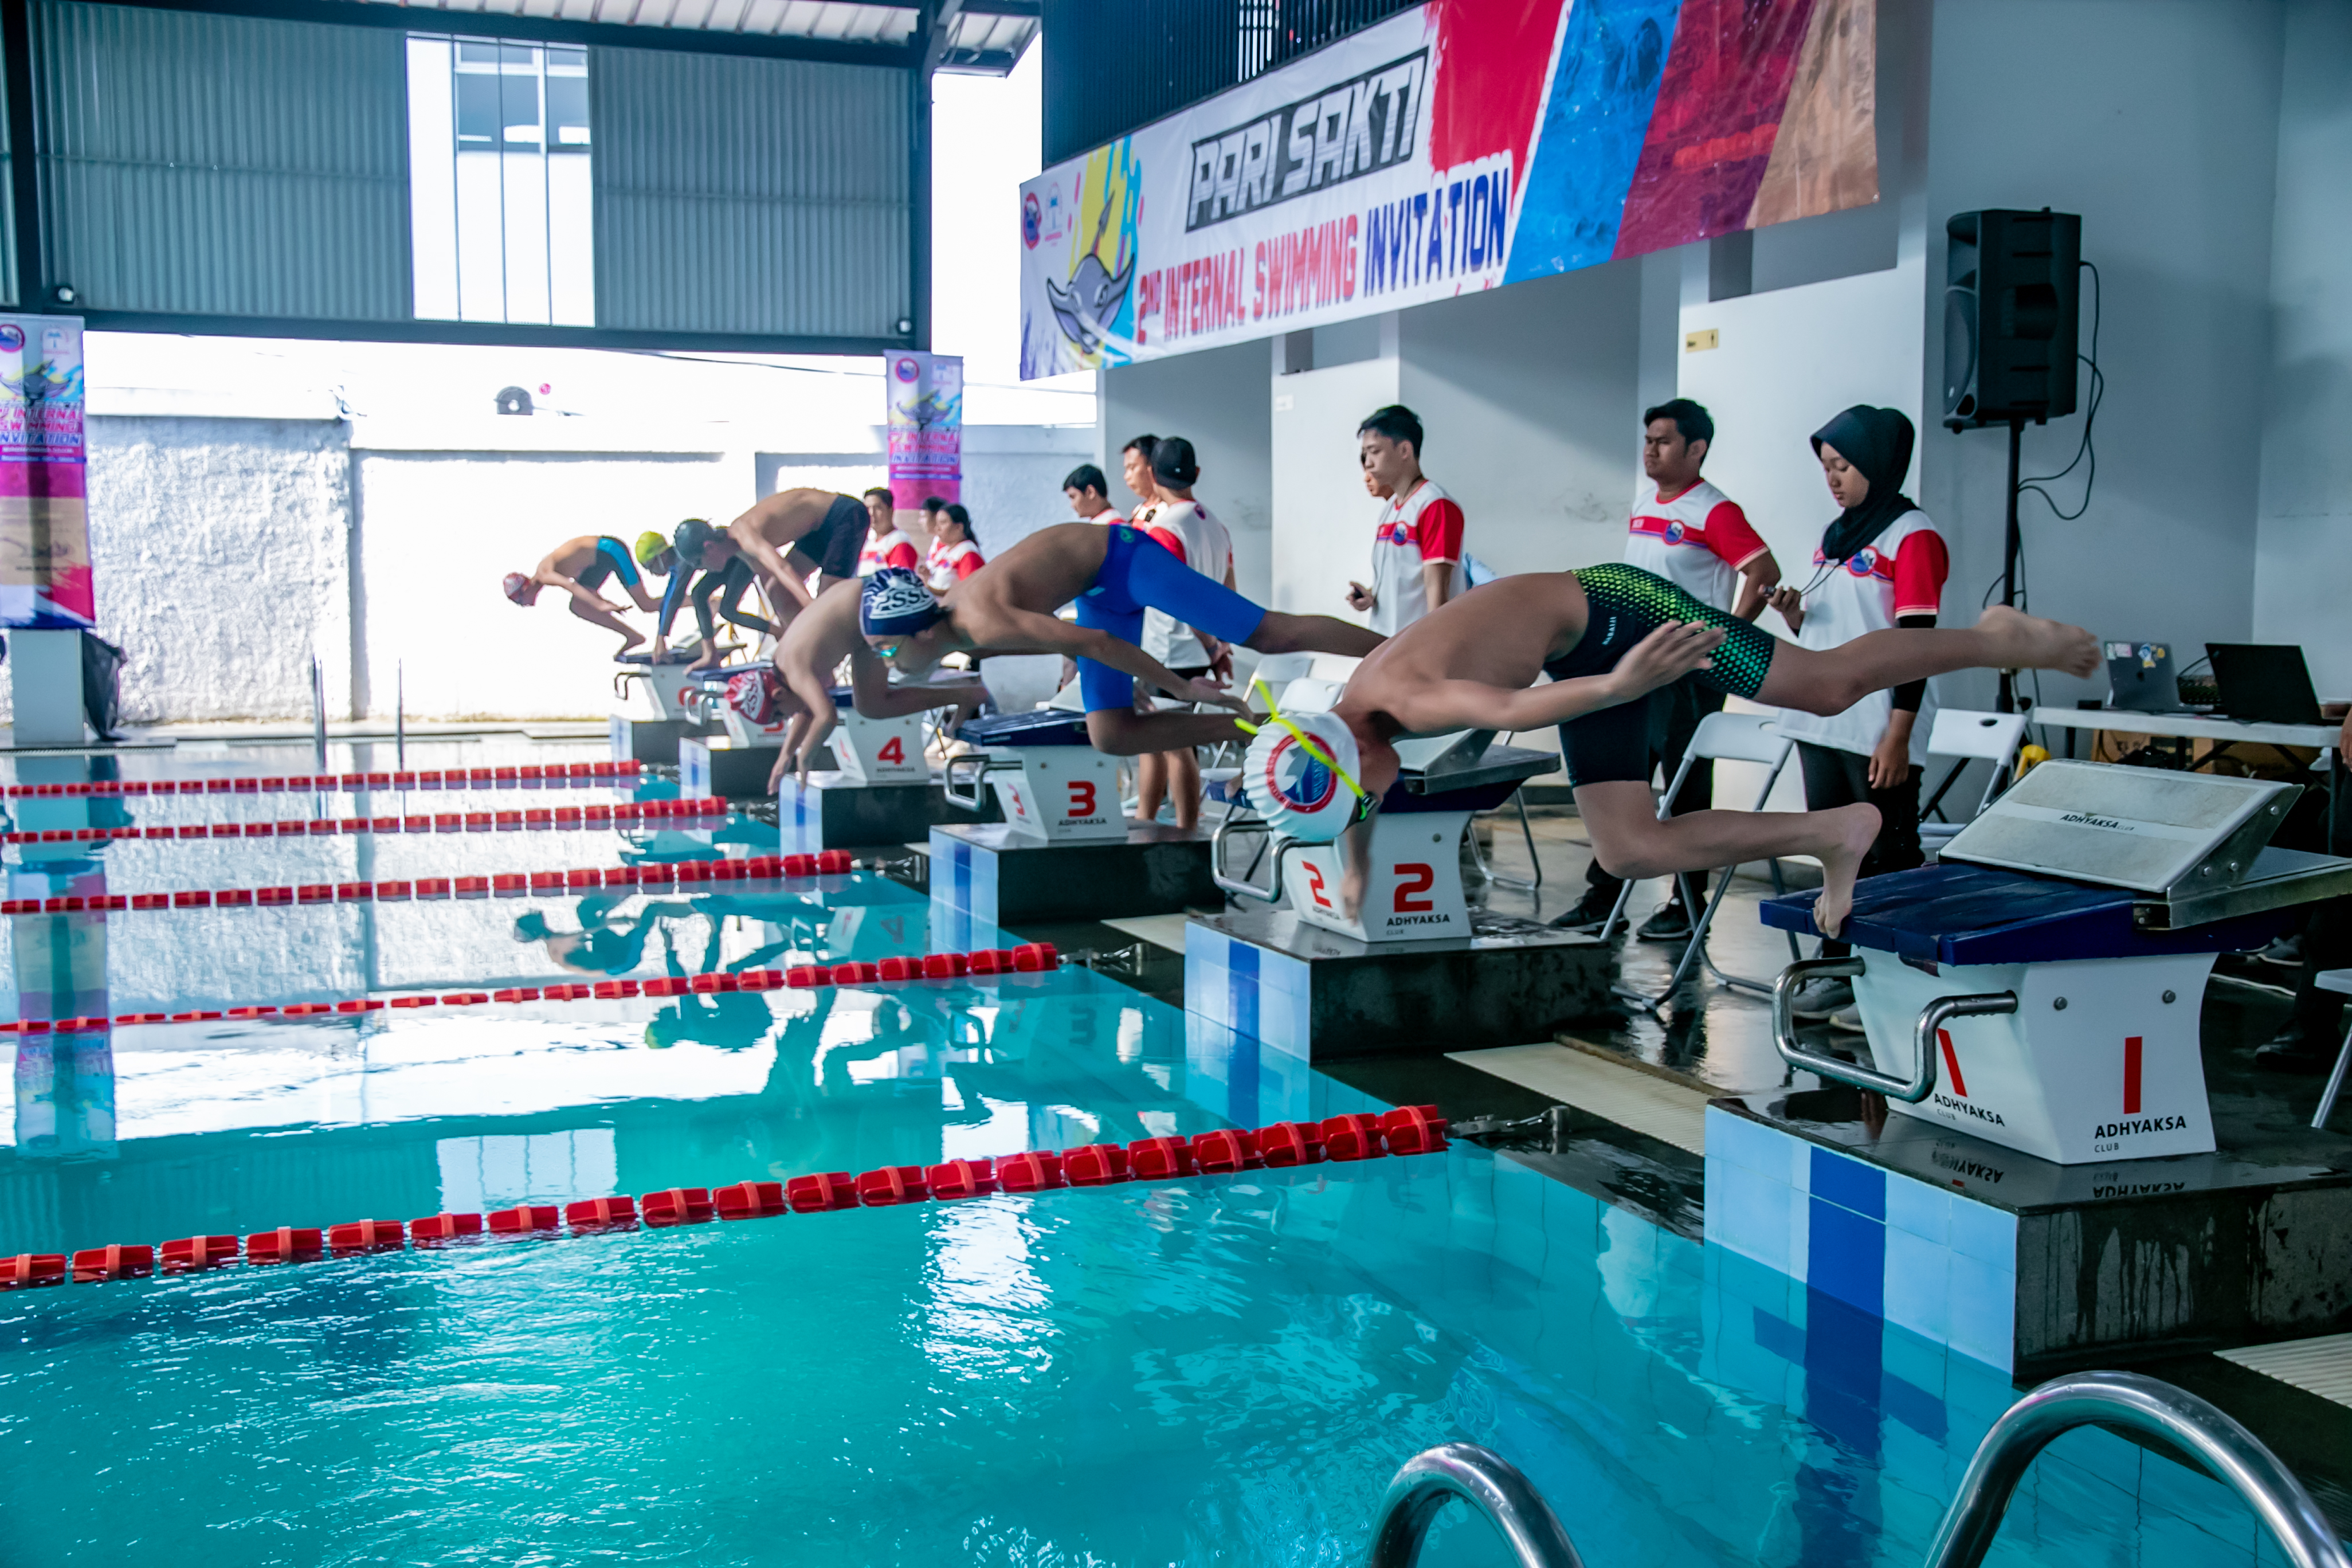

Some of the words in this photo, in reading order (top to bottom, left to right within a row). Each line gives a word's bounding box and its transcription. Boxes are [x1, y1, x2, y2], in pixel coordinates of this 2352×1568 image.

[1188, 113, 1283, 228] PARI
[1282, 56, 1425, 196] SAKTI
[1164, 247, 1246, 342] INTERNAL
[1253, 214, 1358, 322] SWIMMING
[1364, 167, 1508, 297] INVITATION
[877, 736, 906, 766] 4
[1067, 780, 1097, 818] 3
[2059, 814, 2119, 829] ADHYAKSA
[1302, 860, 1333, 908] 2
[1393, 863, 1434, 913] 2
[1386, 914, 1451, 926] ADHYAKSA
[2123, 1036, 2143, 1115] 1
[1934, 1093, 2005, 1127] ADHYAKSA
[2095, 1115, 2187, 1139] ADHYAKSA
[2094, 1142, 2120, 1153] CLUB
